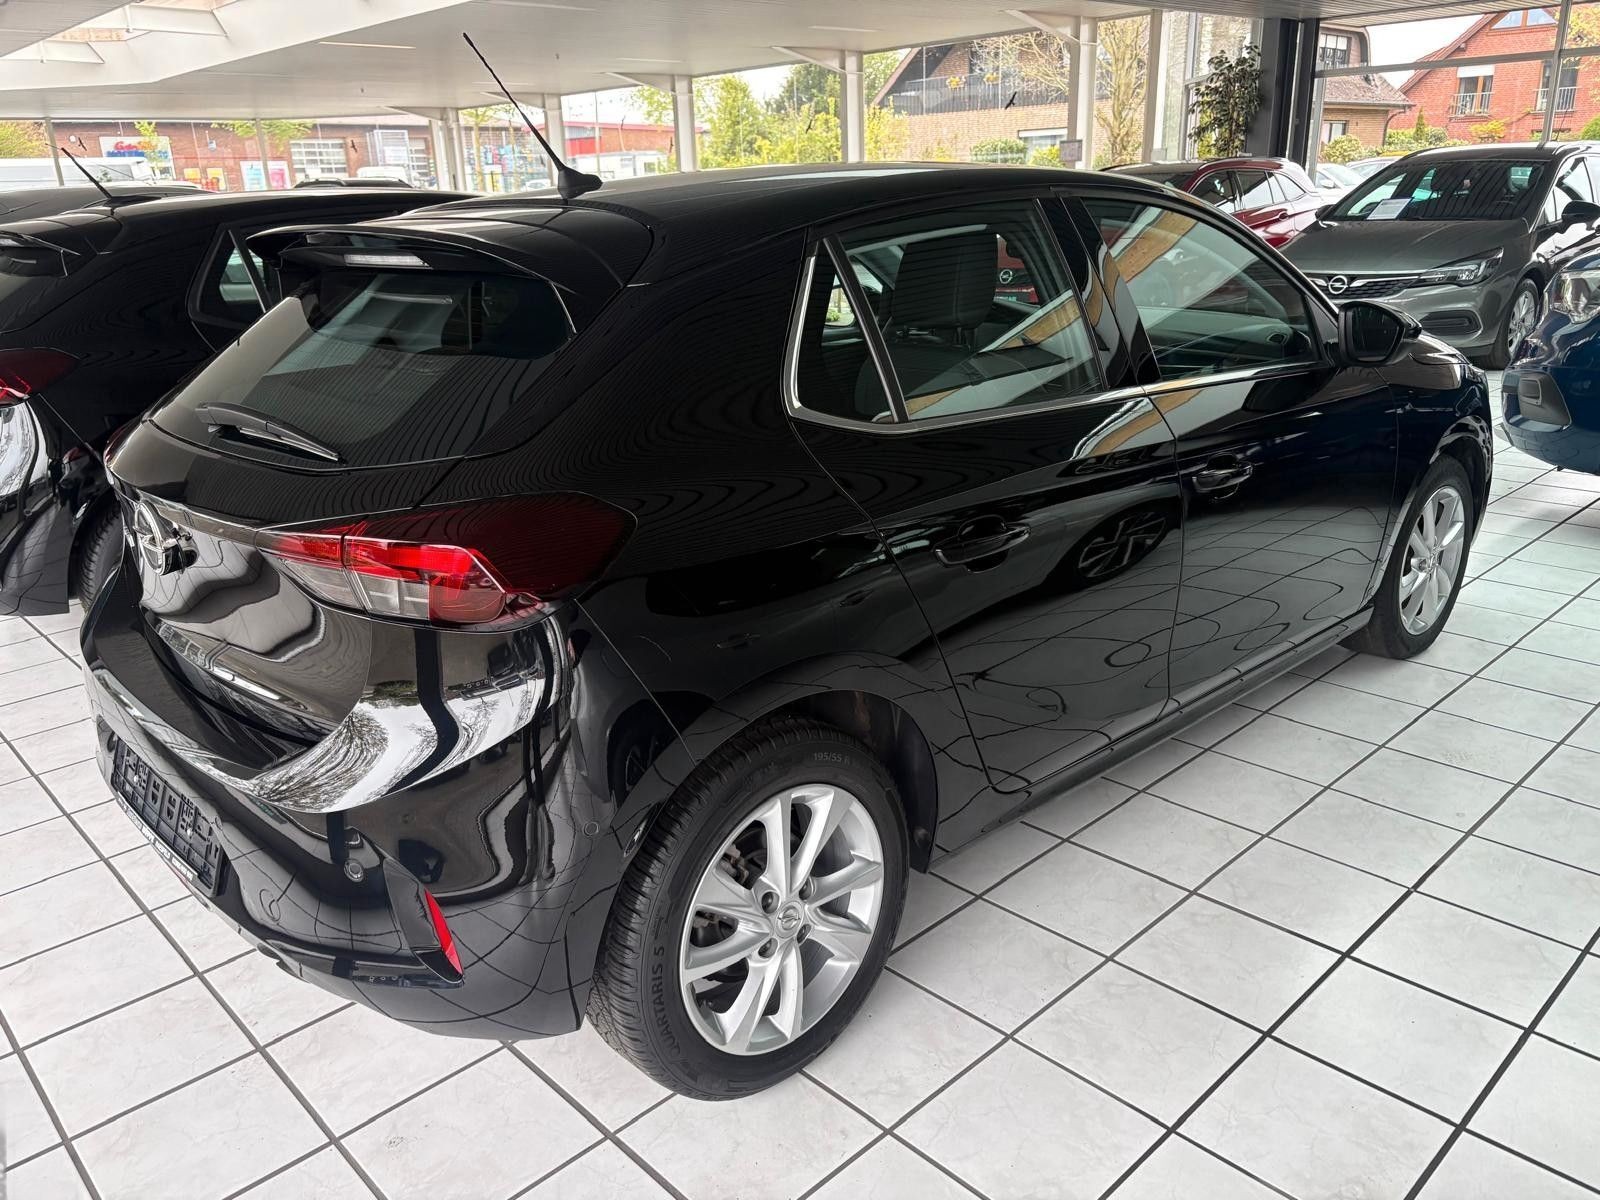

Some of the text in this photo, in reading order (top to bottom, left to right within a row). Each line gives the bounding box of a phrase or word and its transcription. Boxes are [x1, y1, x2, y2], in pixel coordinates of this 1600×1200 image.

[813, 751, 842, 762] 195/55
[651, 945, 681, 1055] QUARTARIS 5
